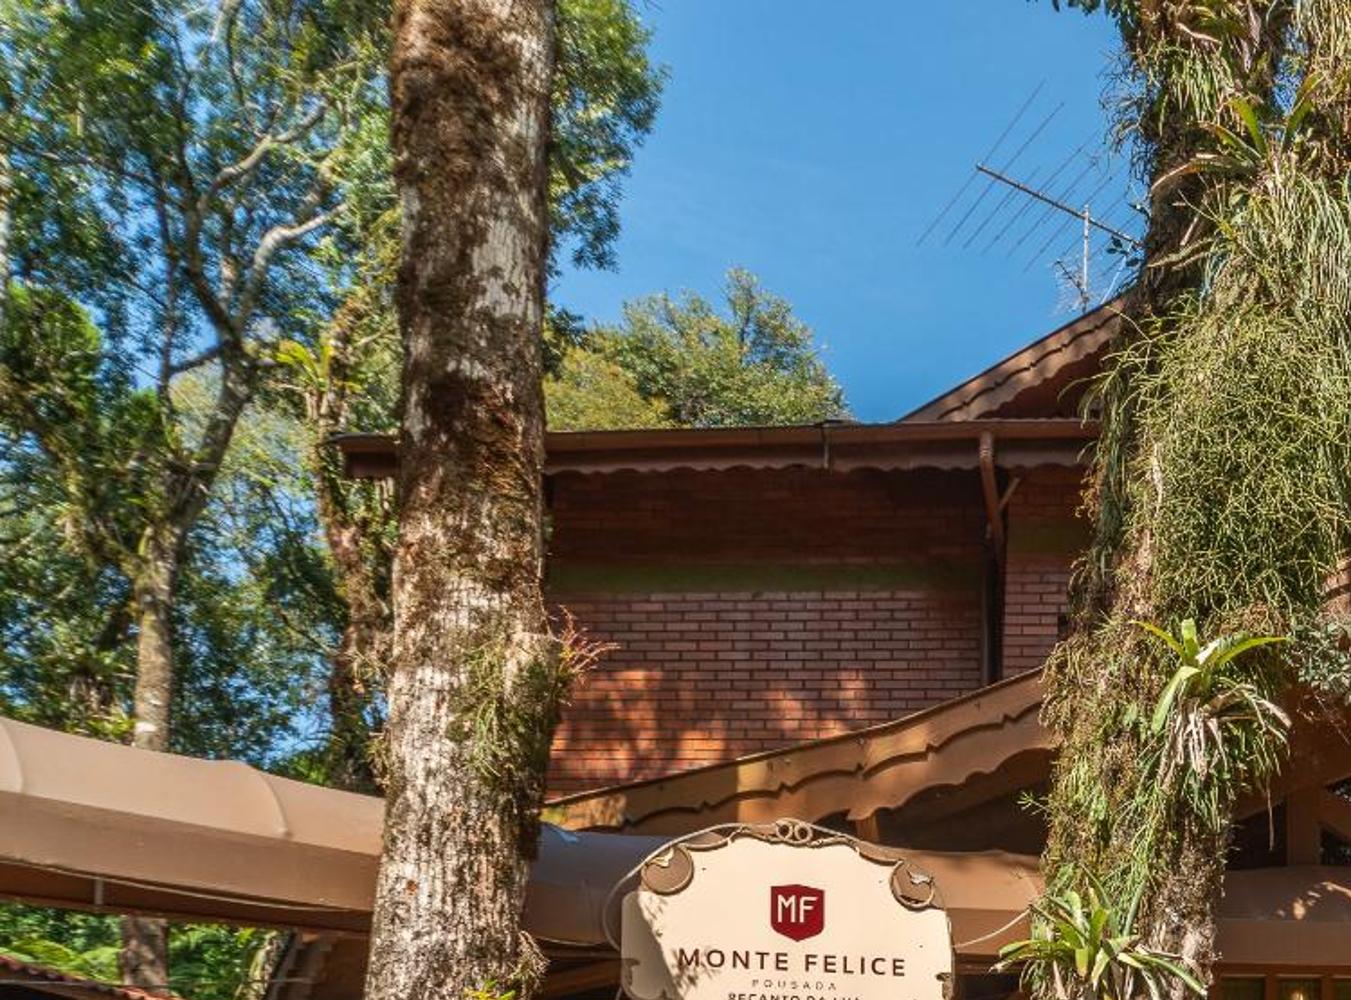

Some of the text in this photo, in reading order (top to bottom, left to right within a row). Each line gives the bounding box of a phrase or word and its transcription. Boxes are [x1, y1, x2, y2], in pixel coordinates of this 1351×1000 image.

[776, 894, 818, 923] MF
[678, 948, 905, 976] MONTE FELICE
[751, 979, 837, 990] POUSADA
